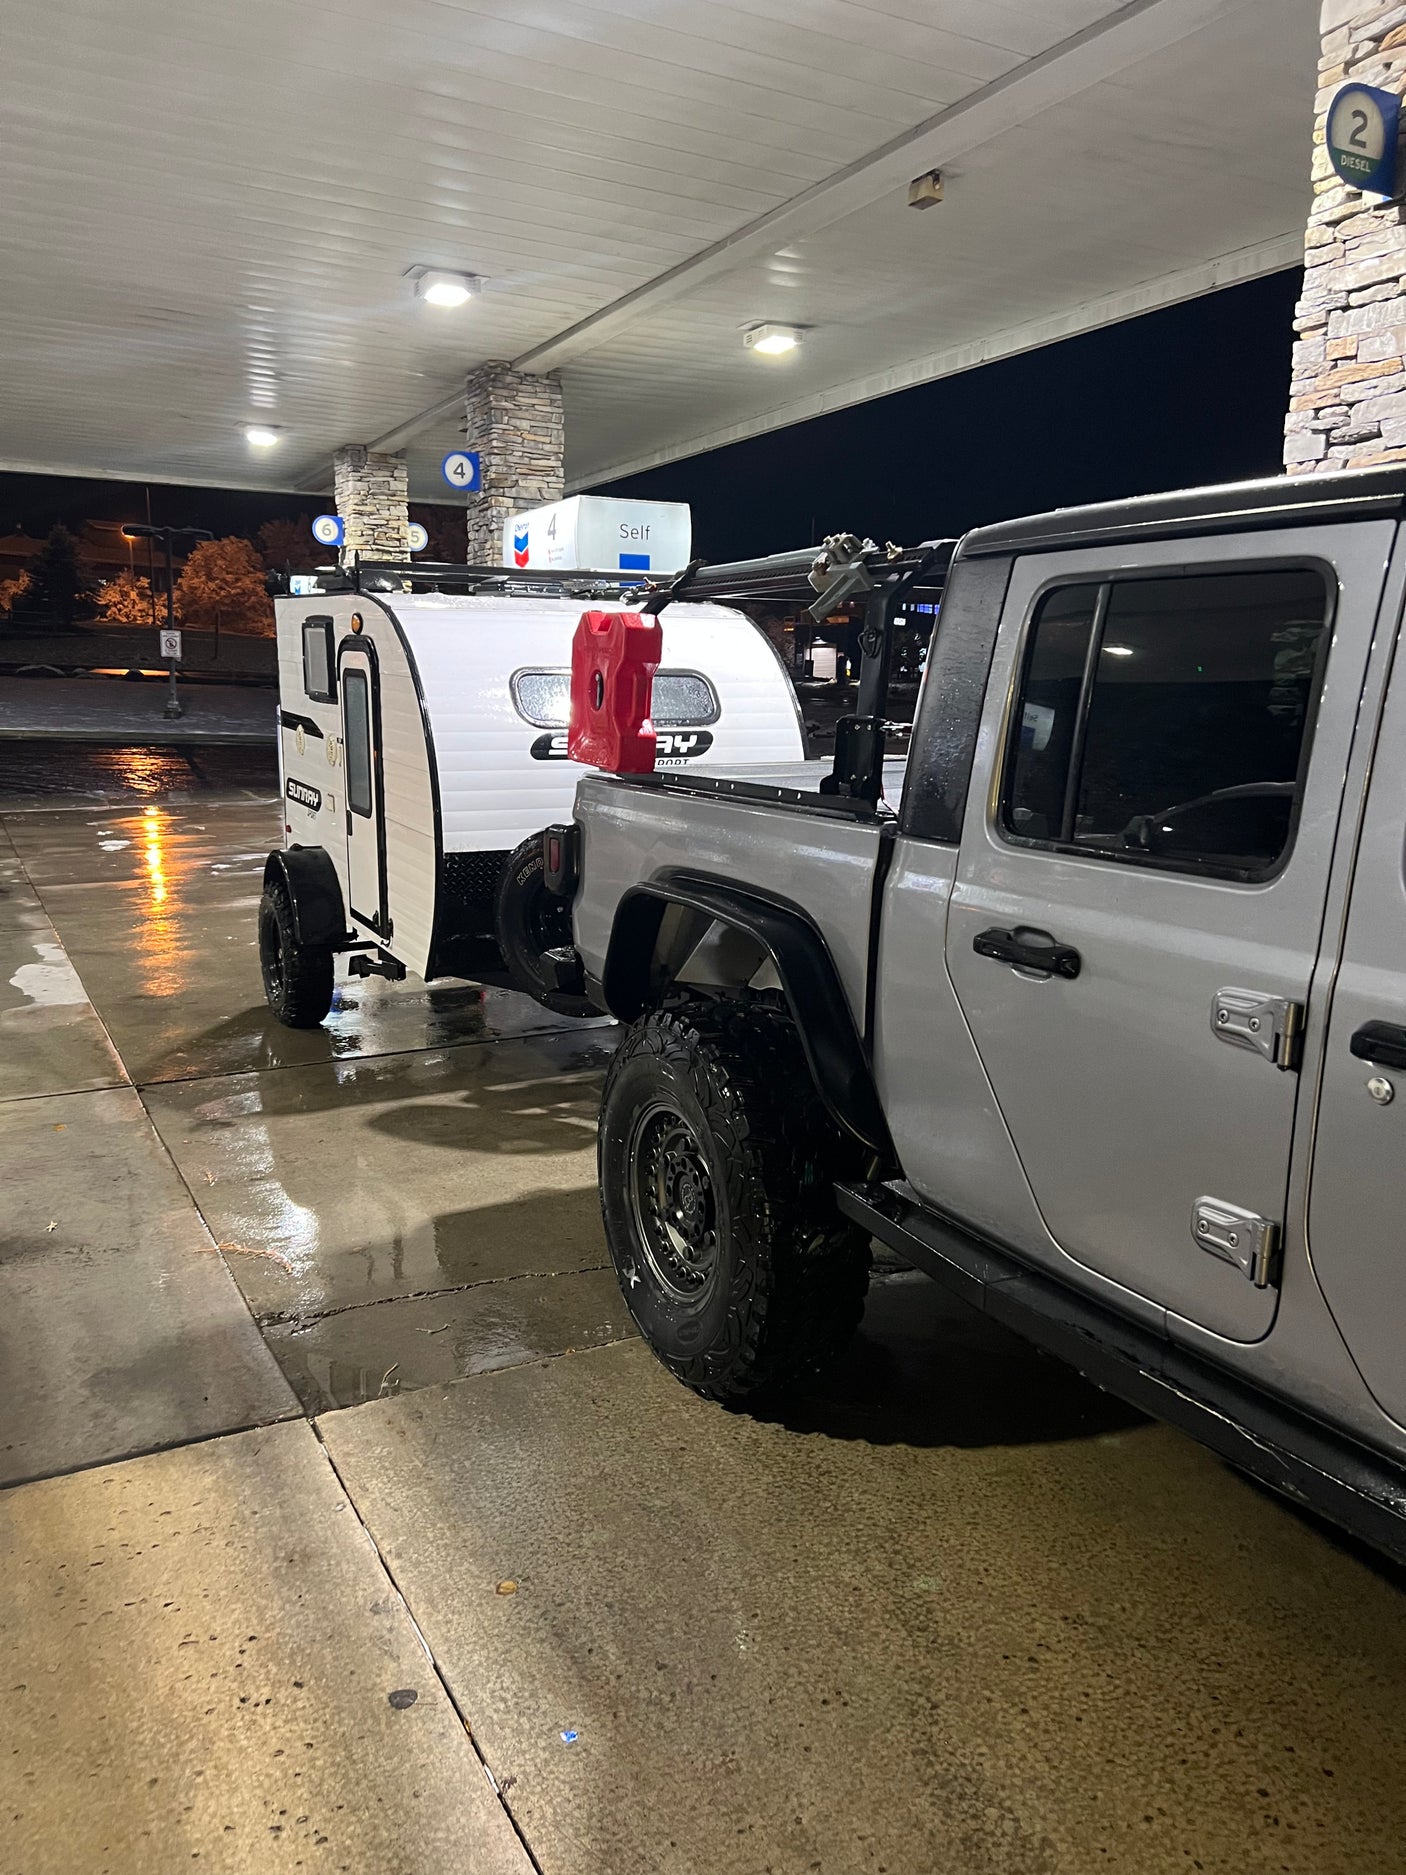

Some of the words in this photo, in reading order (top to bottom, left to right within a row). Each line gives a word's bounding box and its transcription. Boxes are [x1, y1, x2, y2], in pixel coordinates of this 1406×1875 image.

[1349, 109, 1368, 149] 2
[1341, 154, 1371, 173] DIESEL
[453, 462, 466, 479] 4
[321, 523, 332, 537] 6
[547, 513, 556, 541] 4
[619, 523, 651, 540] Self
[410, 531, 420, 544] 5
[288, 781, 319, 807] SUNRAY
